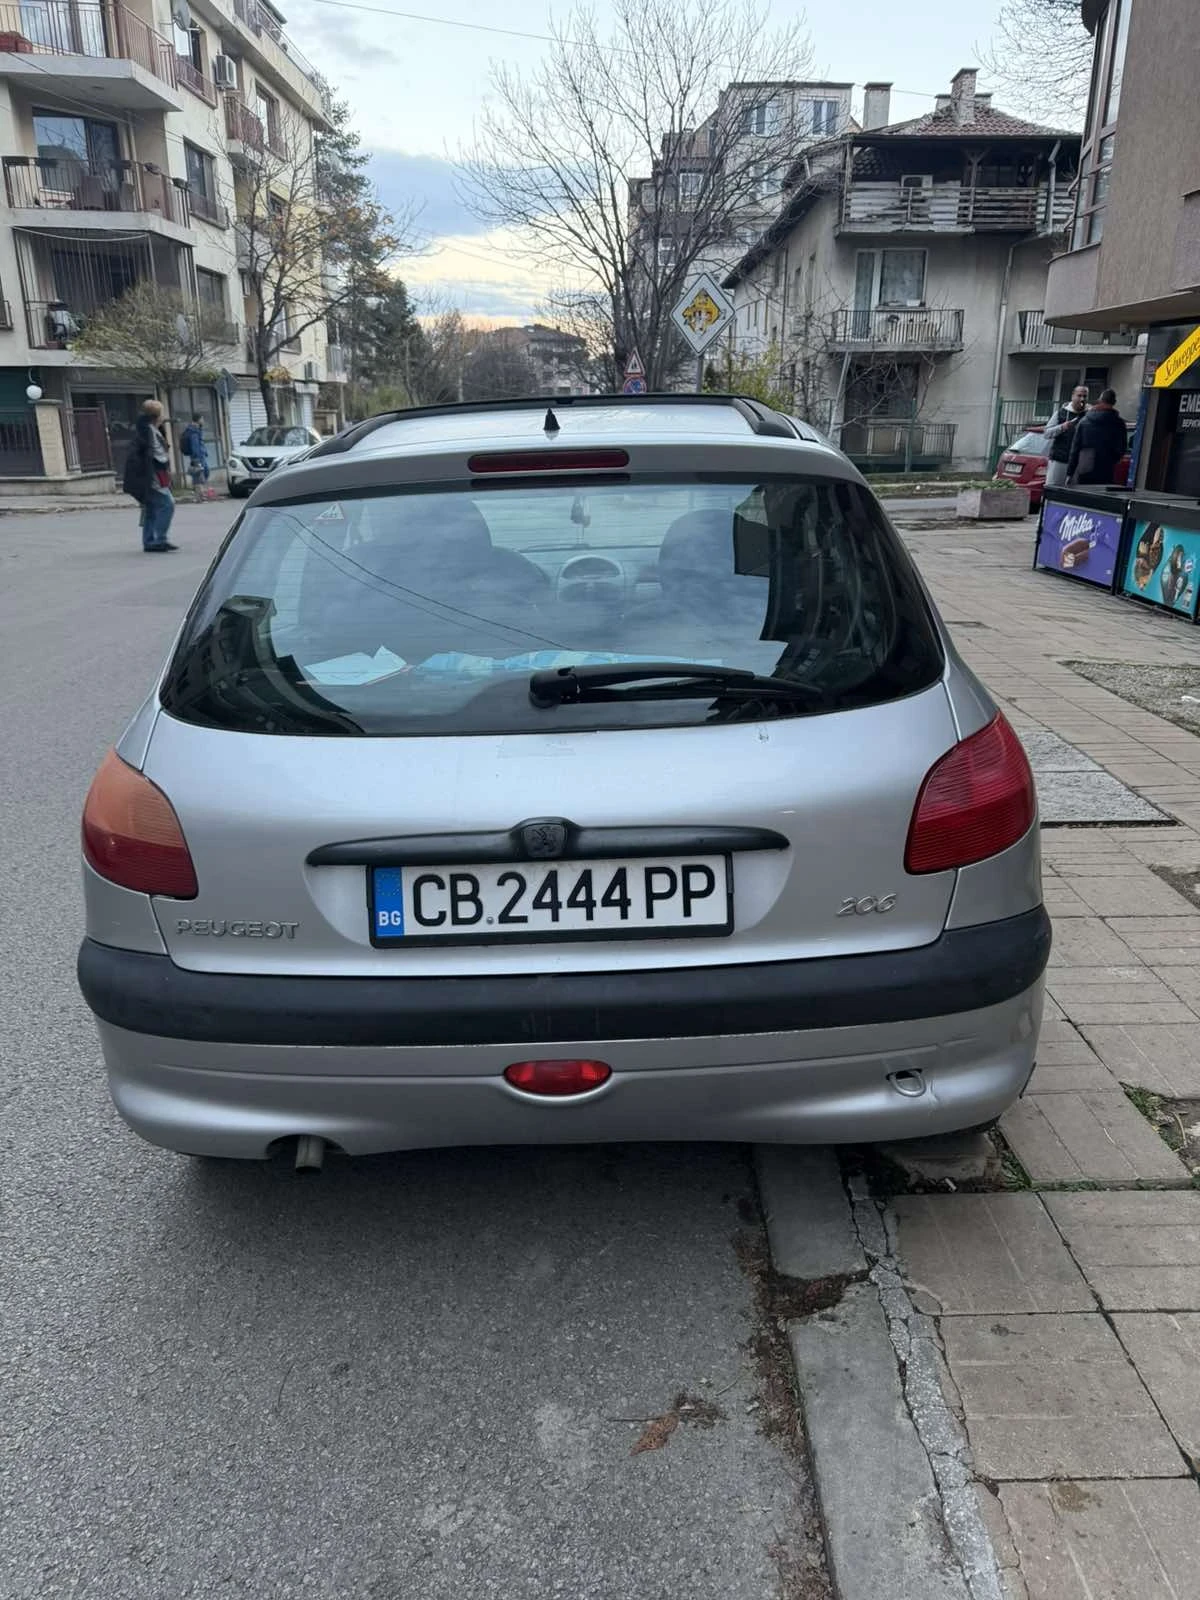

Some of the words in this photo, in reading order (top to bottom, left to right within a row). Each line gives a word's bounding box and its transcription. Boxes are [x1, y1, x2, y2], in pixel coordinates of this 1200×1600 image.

[1059, 512, 1093, 541] Milka
[413, 873, 484, 927] CB
[496, 866, 632, 925] 2444
[644, 864, 716, 919] PP
[836, 893, 896, 916] 206
[176, 919, 299, 938] PEUGEOT
[378, 910, 402, 927] BG
